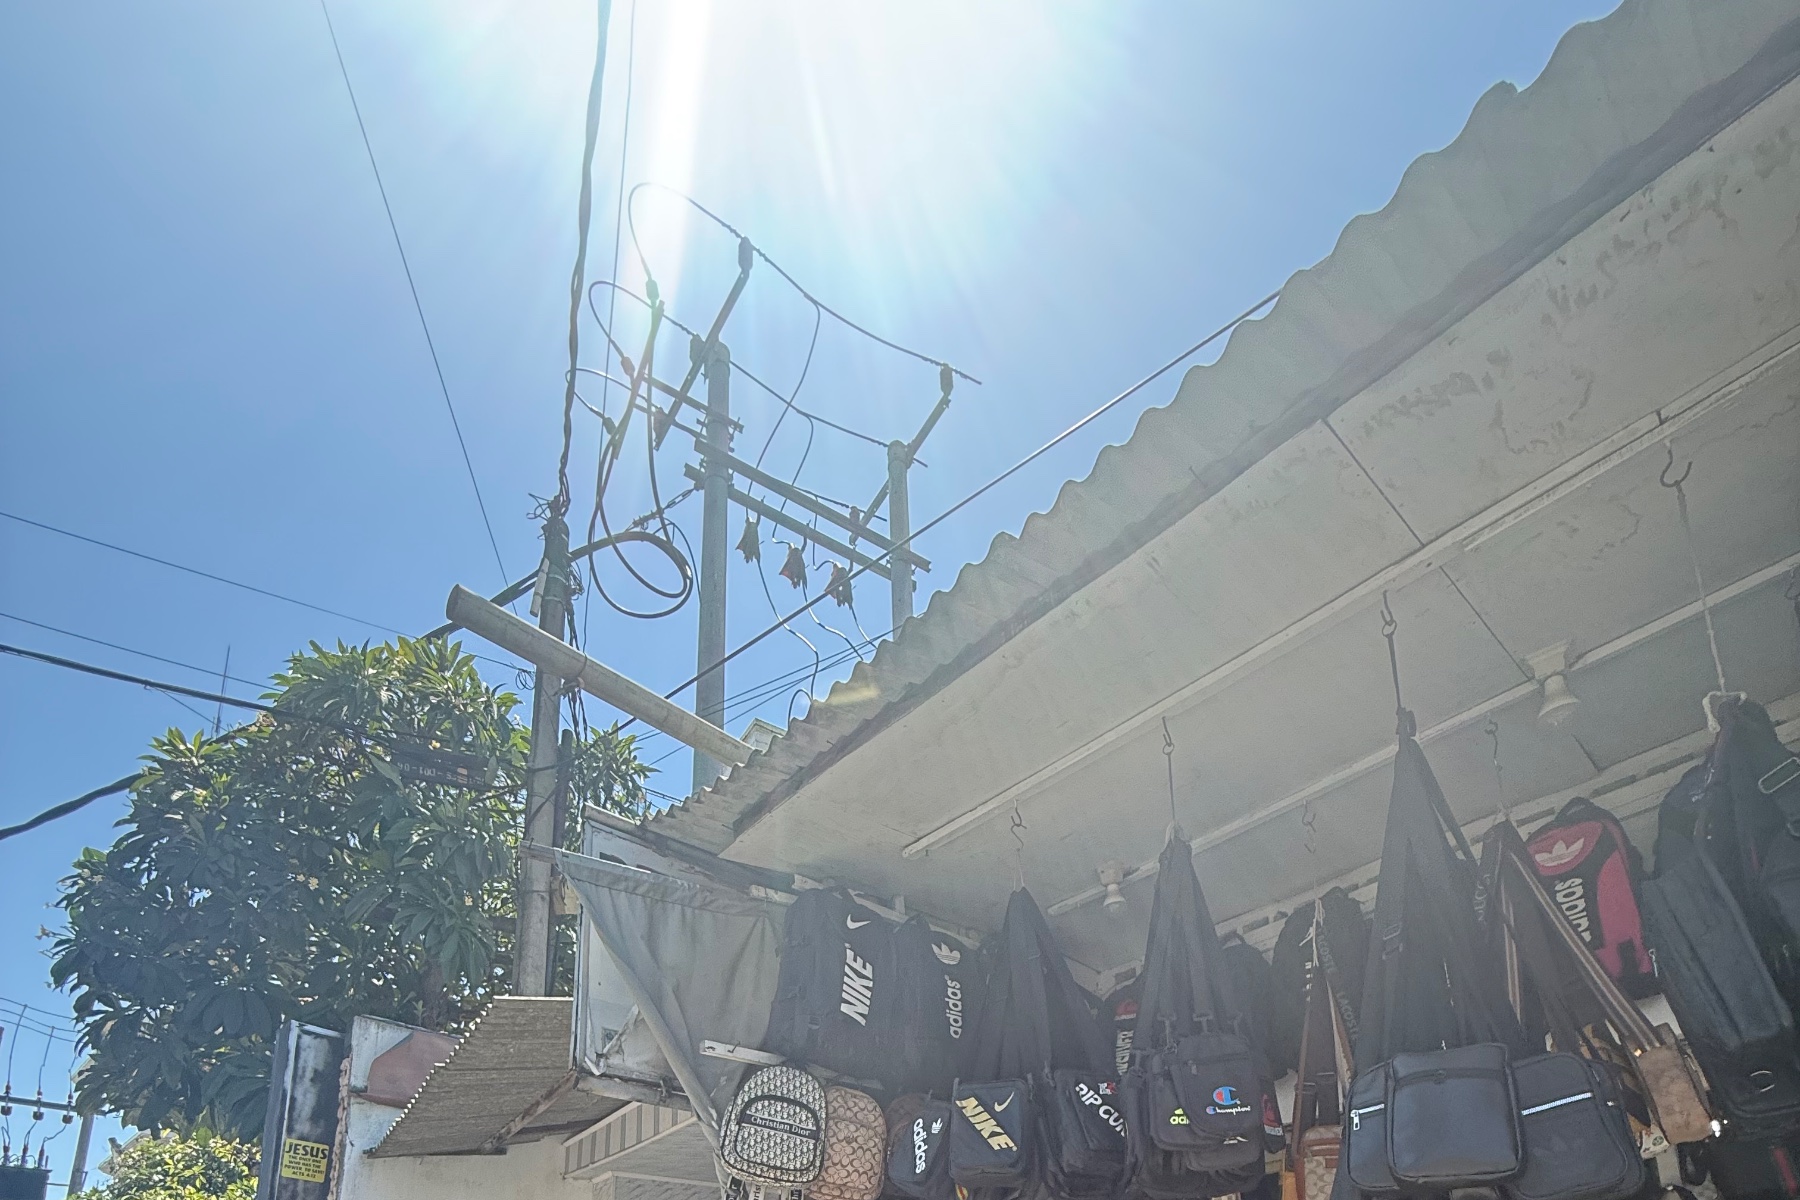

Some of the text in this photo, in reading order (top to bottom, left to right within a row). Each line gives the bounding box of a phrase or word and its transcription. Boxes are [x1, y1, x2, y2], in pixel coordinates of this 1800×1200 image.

[840, 948, 874, 1027] NIKE
[945, 980, 963, 1039] adidas
[285, 1142, 329, 1160] JESUS
[751, 1115, 811, 1137] Christian Dior
[914, 1118, 929, 1174] adidas
[955, 1096, 1016, 1151] NIKE
